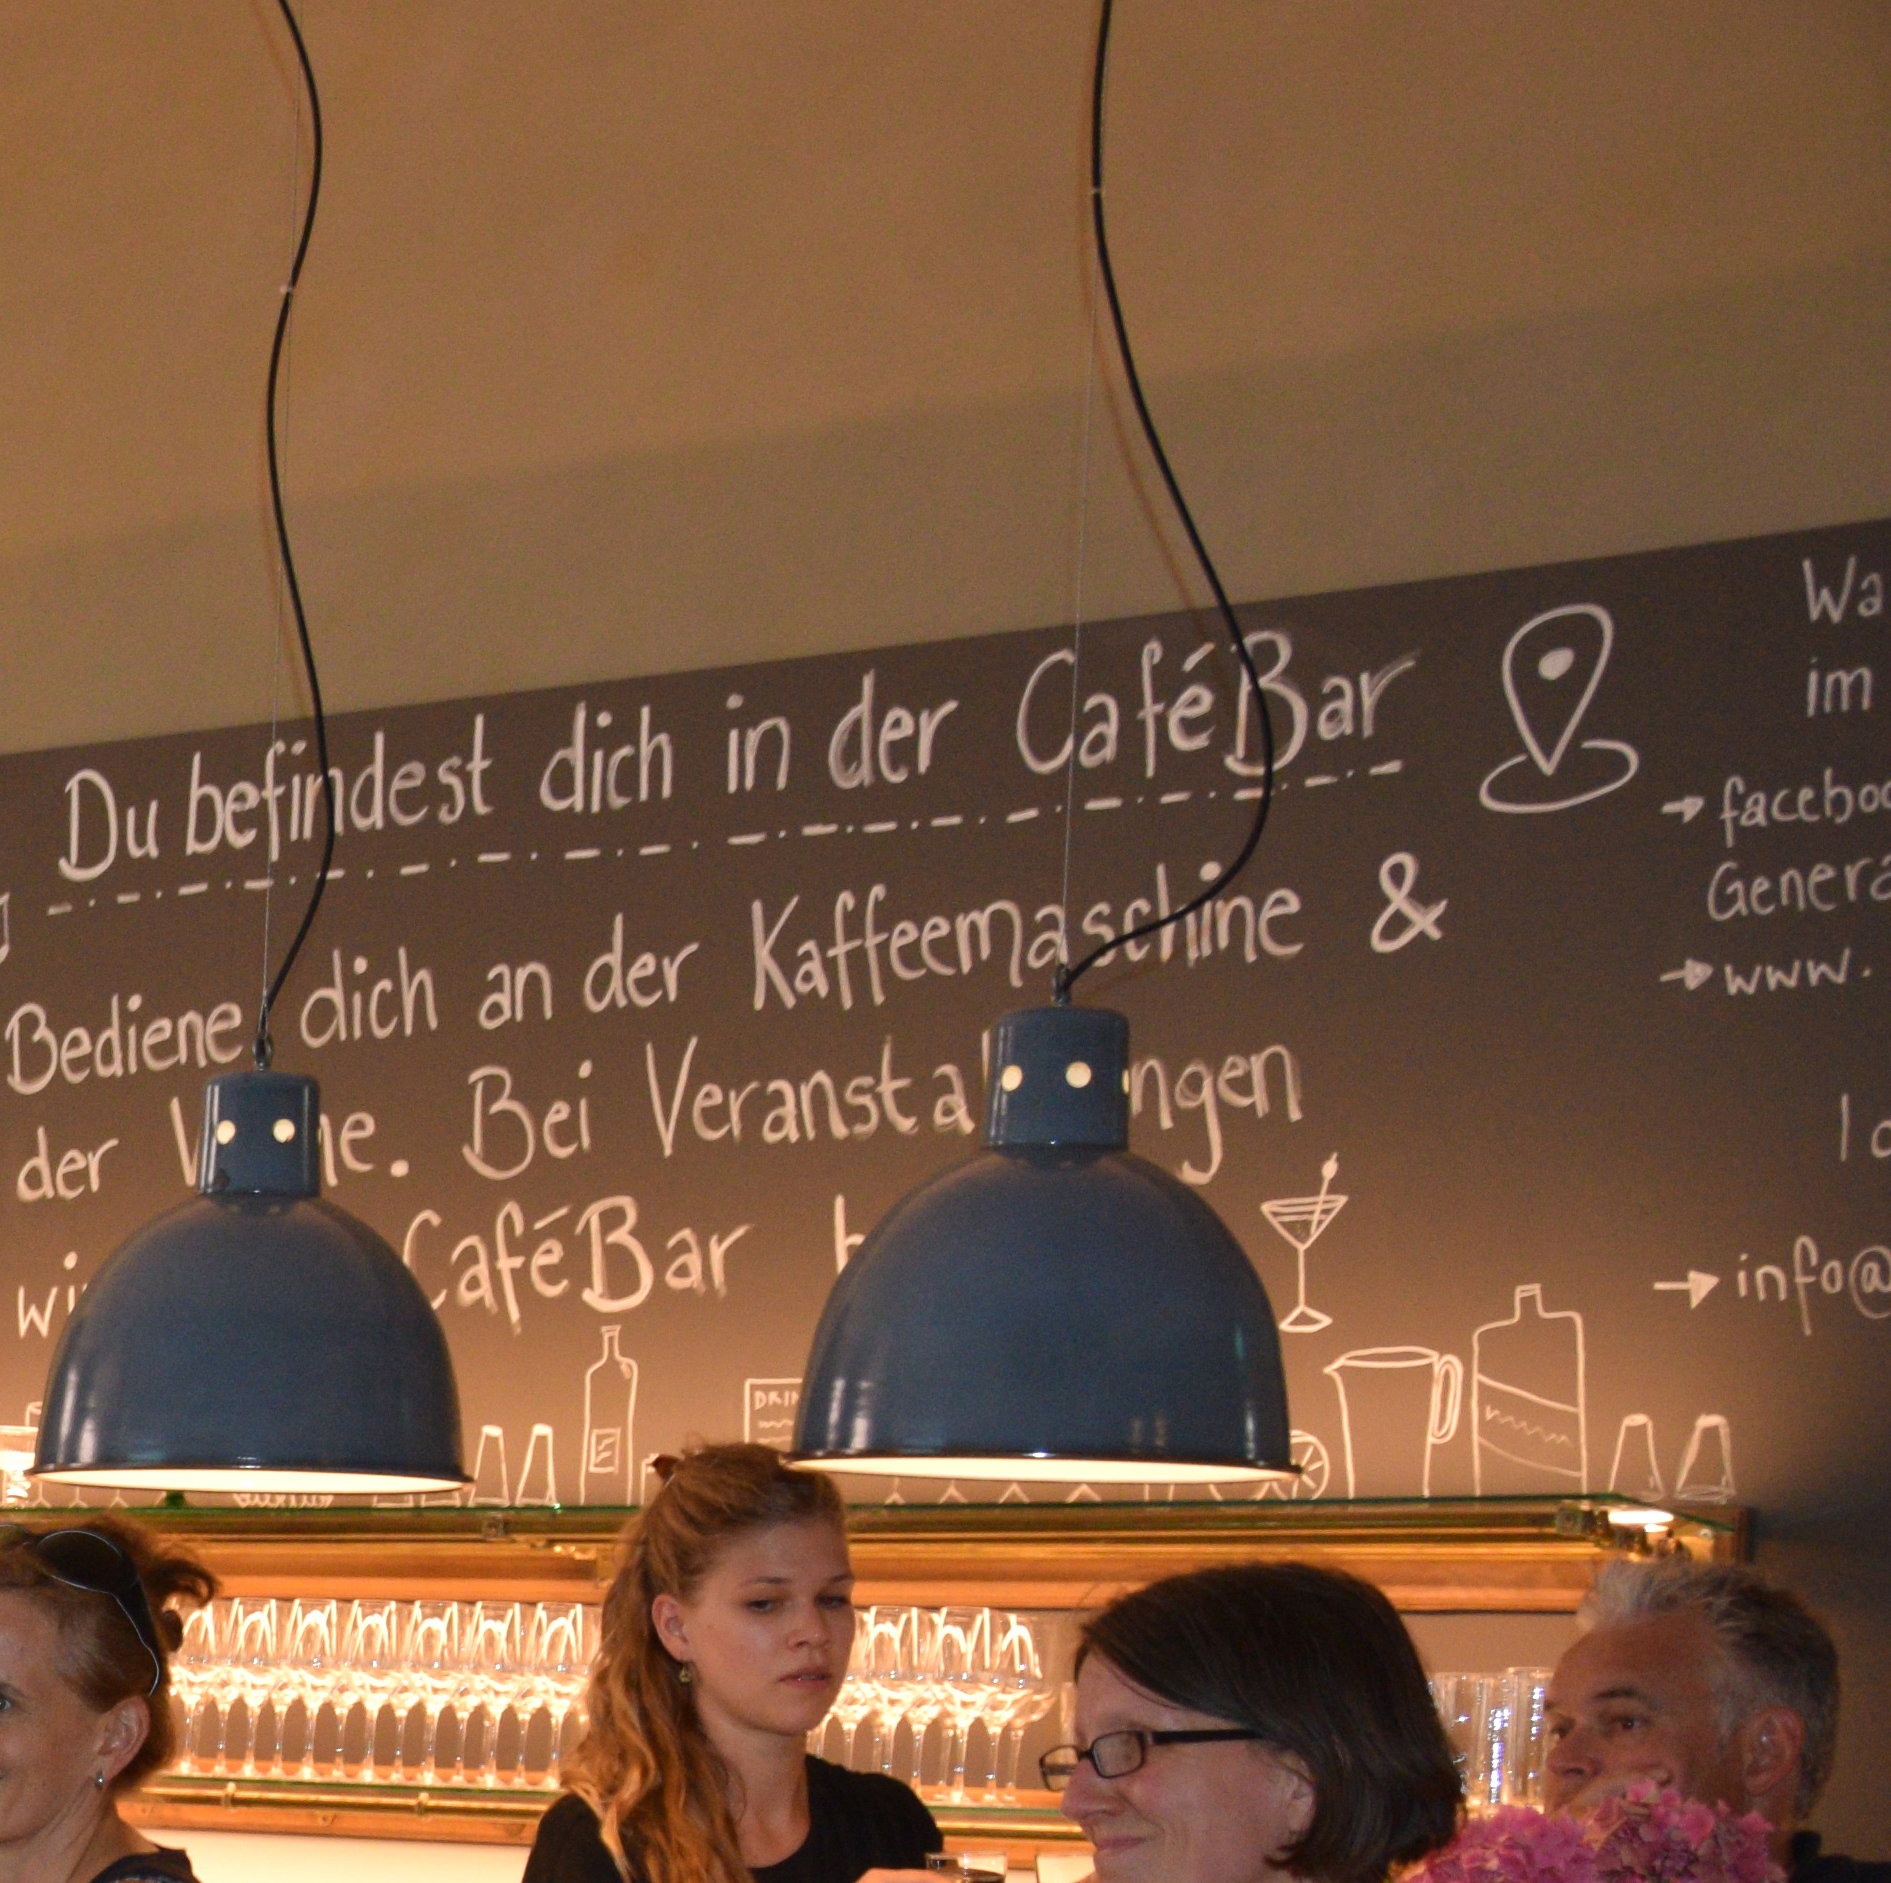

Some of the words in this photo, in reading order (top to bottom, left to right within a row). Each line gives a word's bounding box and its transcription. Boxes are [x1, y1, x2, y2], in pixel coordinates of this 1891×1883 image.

[1806, 657, 1874, 718] im
[59, 767, 158, 881] Du
[185, 712, 493, 861] befindest
[540, 702, 673, 813] dich
[725, 693, 791, 794] in
[827, 668, 959, 789] der
[4, 994, 243, 1094] Bediene
[300, 944, 438, 1048] dich
[478, 960, 552, 1031] an
[582, 911, 699, 1013] der
[752, 860, 1304, 1010] Kaffeemaschine
[1371, 851, 1448, 954] &
[1724, 947, 1873, 996] www.
[17, 1125, 119, 1202] der
[462, 1058, 594, 1180] Bei
